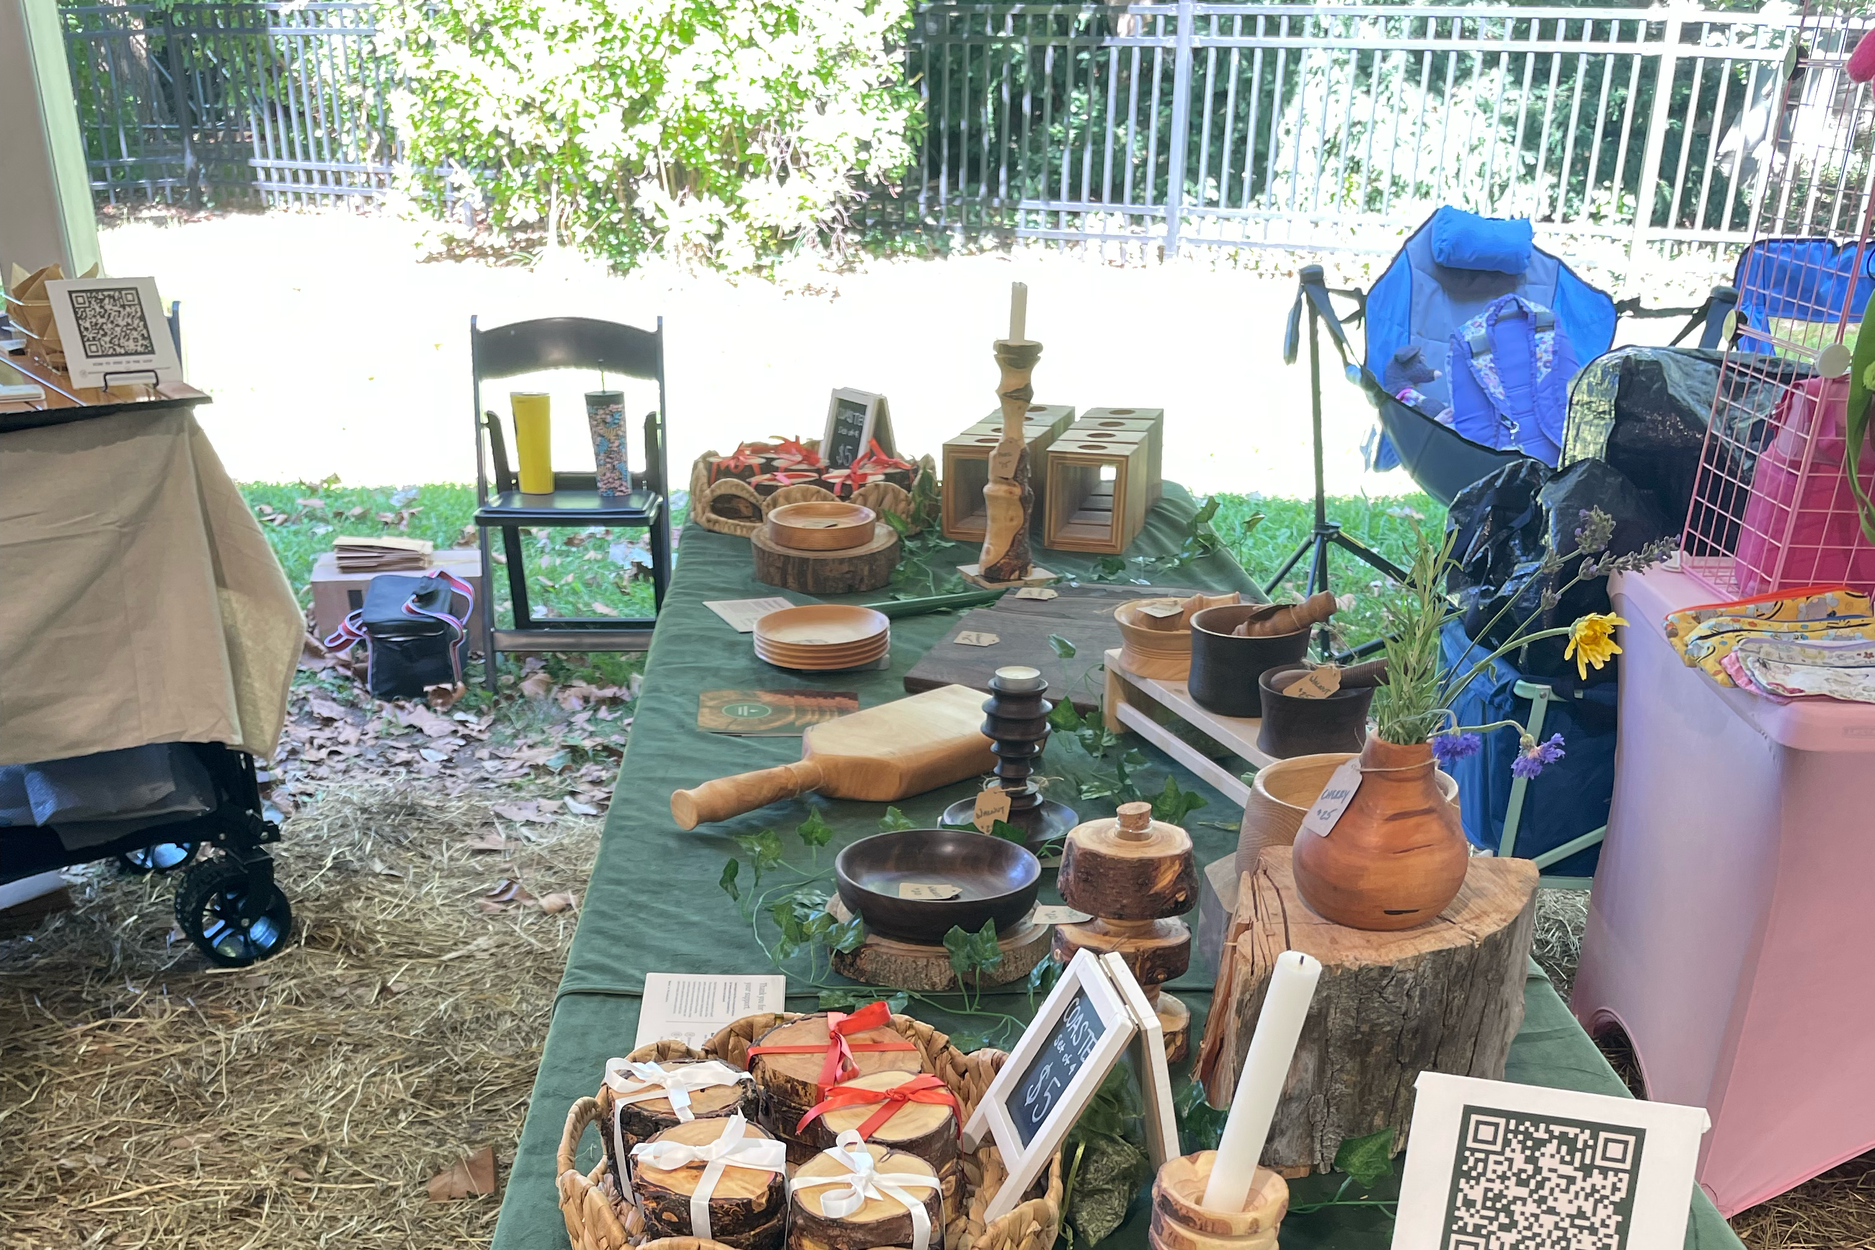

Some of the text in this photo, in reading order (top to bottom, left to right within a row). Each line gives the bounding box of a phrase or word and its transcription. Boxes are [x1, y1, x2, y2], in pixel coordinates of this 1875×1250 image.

[836, 443, 853, 466] $5
[1321, 789, 1350, 804] CHERRY
[1316, 808, 1338, 820] $25
[1024, 1061, 1061, 1123] $5
